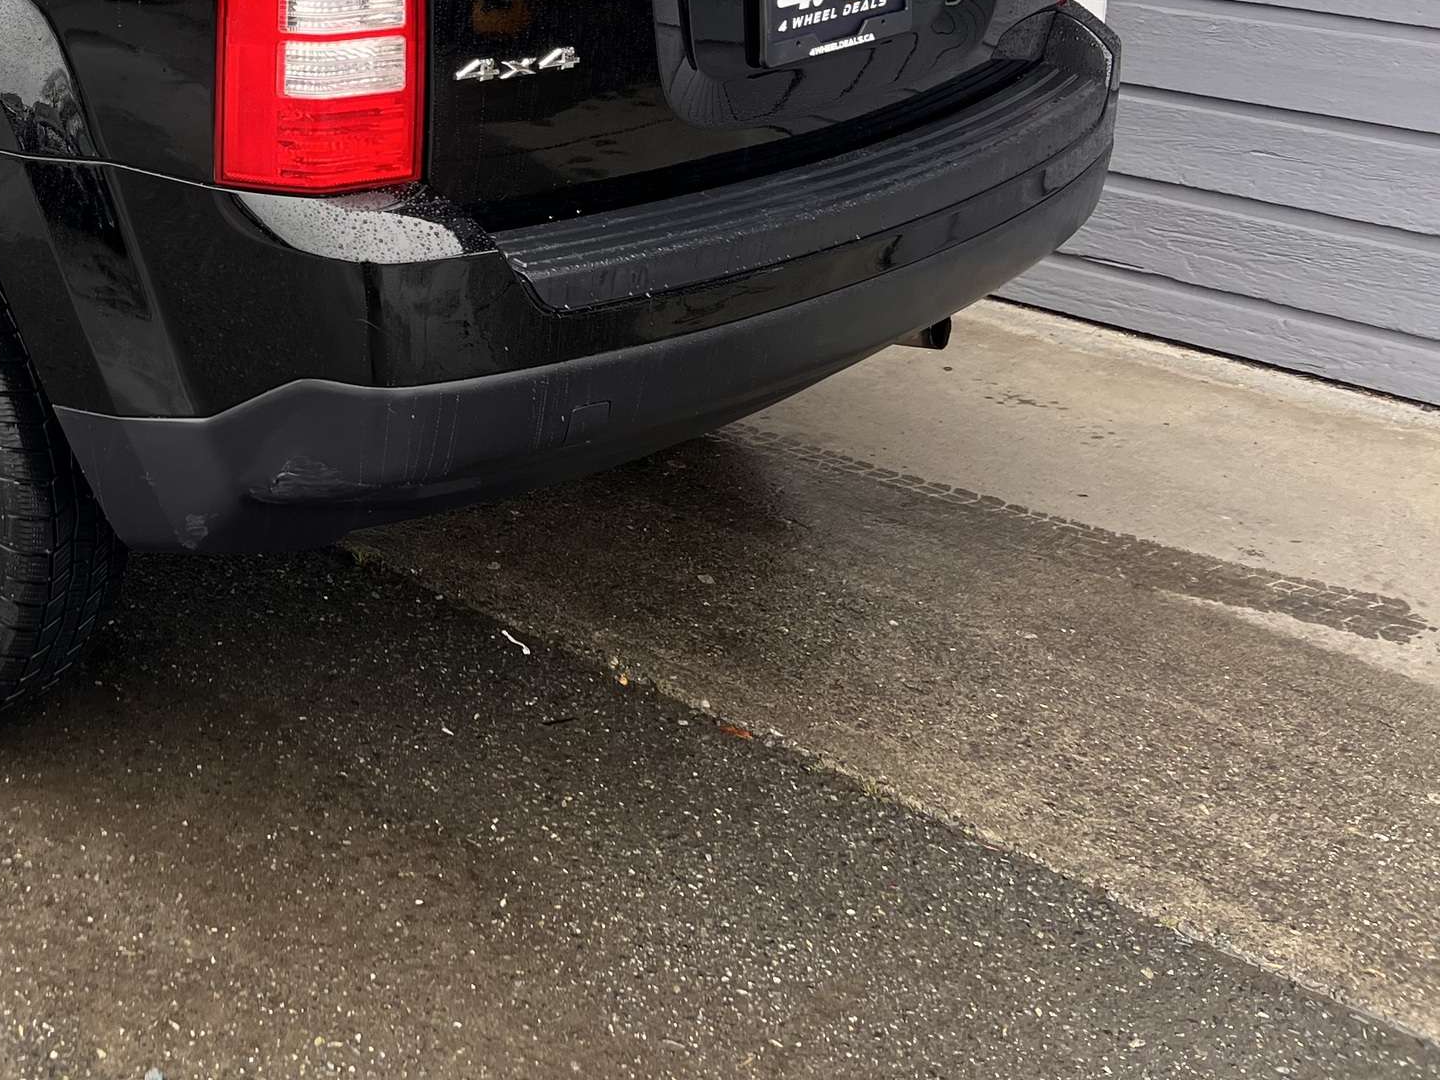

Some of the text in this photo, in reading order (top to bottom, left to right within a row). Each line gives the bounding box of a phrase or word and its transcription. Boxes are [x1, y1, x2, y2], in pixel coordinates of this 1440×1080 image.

[777, 19, 788, 32] 4
[792, 7, 838, 30] WHEEL
[455, 46, 580, 82] 4x4
